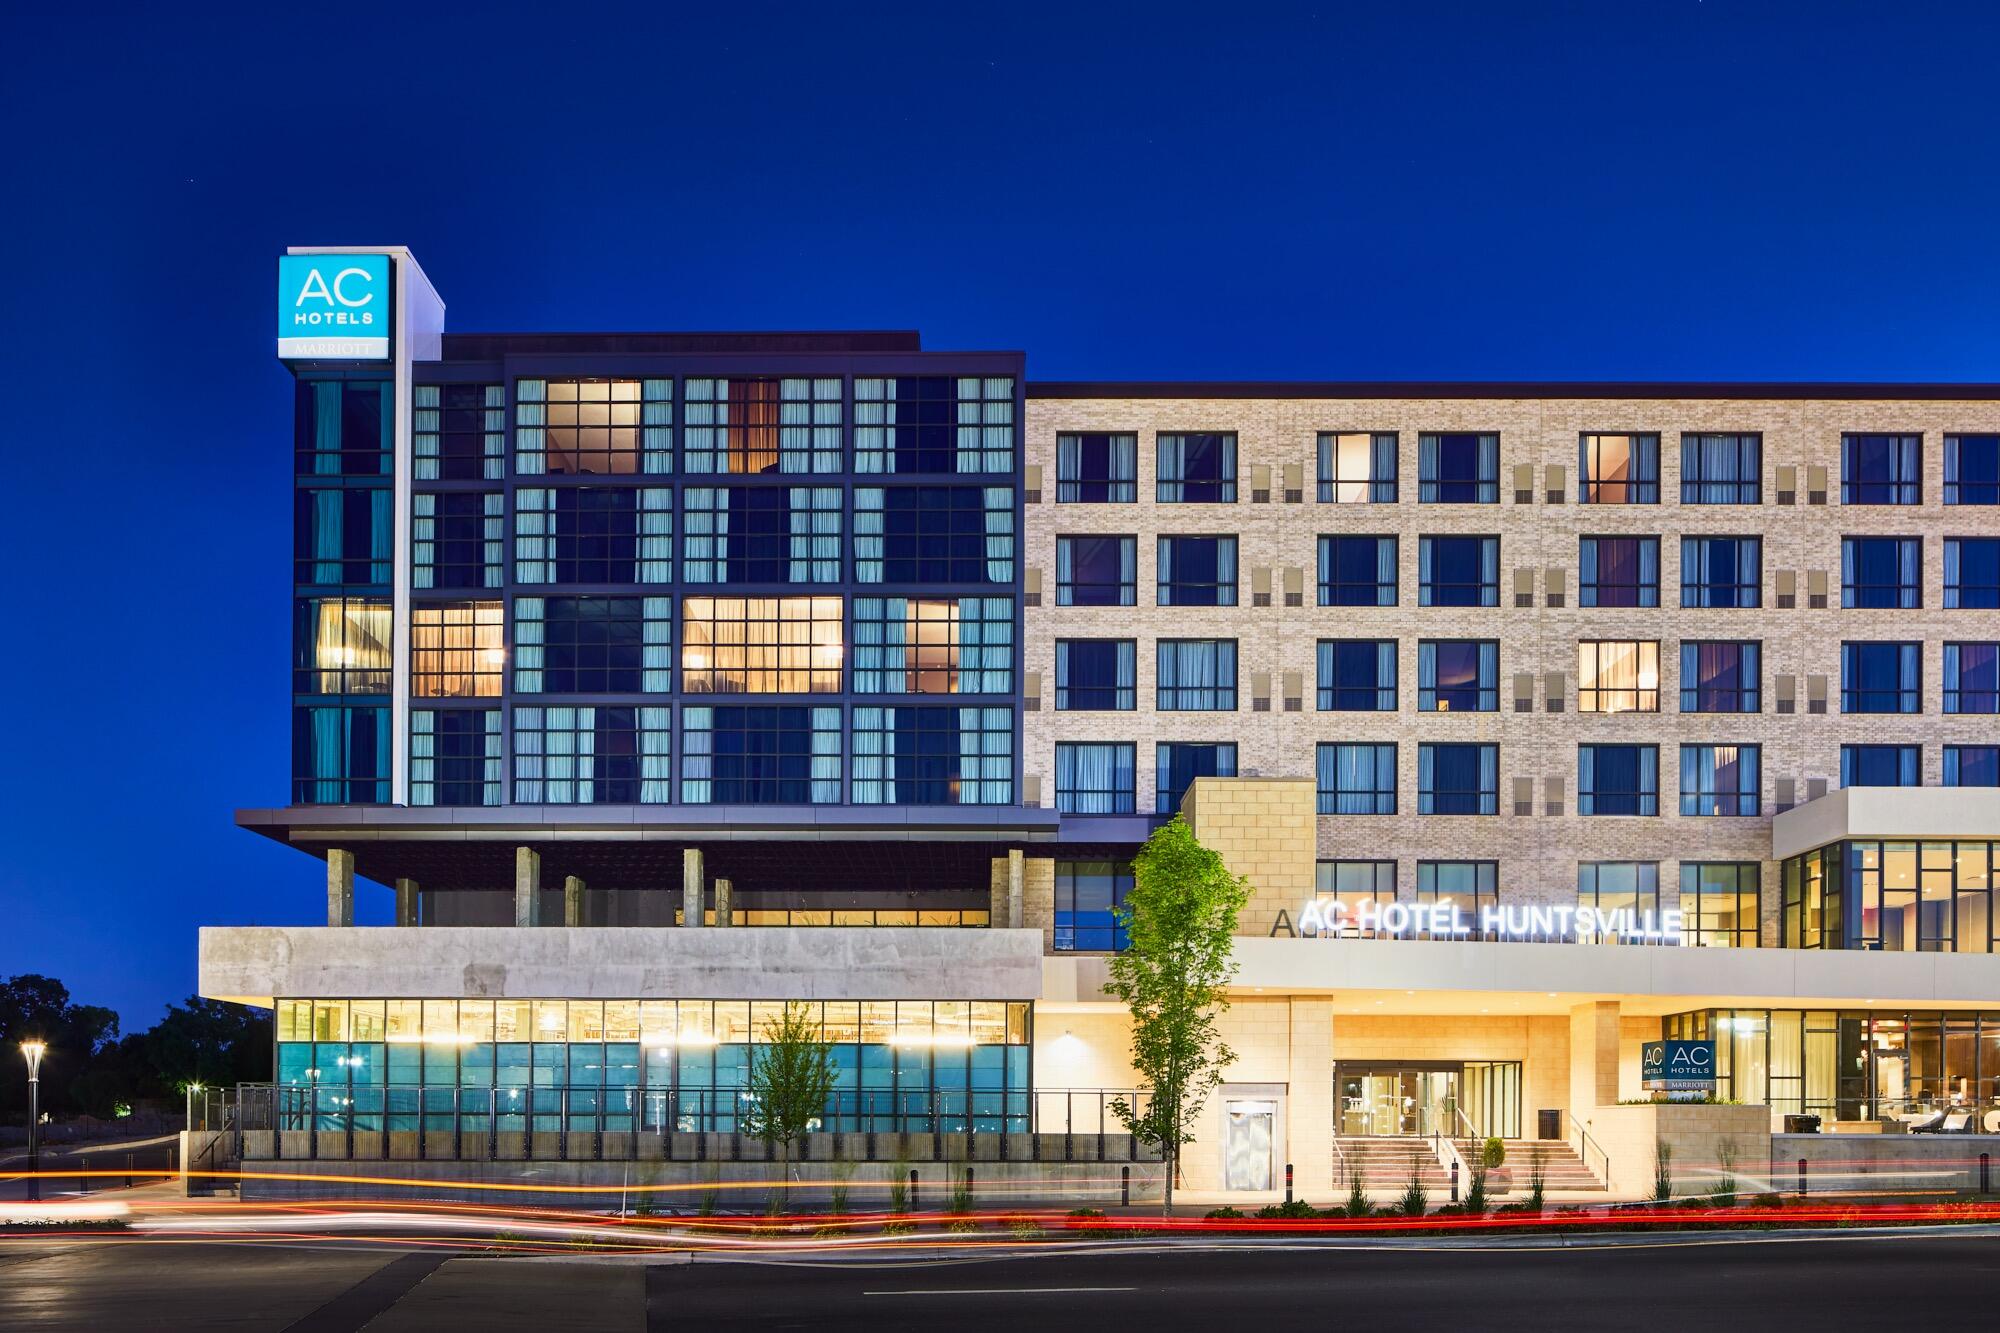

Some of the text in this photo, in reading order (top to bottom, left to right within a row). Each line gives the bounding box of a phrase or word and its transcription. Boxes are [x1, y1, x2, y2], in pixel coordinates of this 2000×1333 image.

[295, 267, 373, 307] AC
[294, 312, 373, 325] HOTELS
[294, 343, 372, 355] MARRIOTT
[1299, 900, 1348, 931] AC
[1483, 905, 1681, 937] HUNTSVILLE
[1644, 1046, 1663, 1067] AC
[1671, 1046, 1709, 1065] AC
